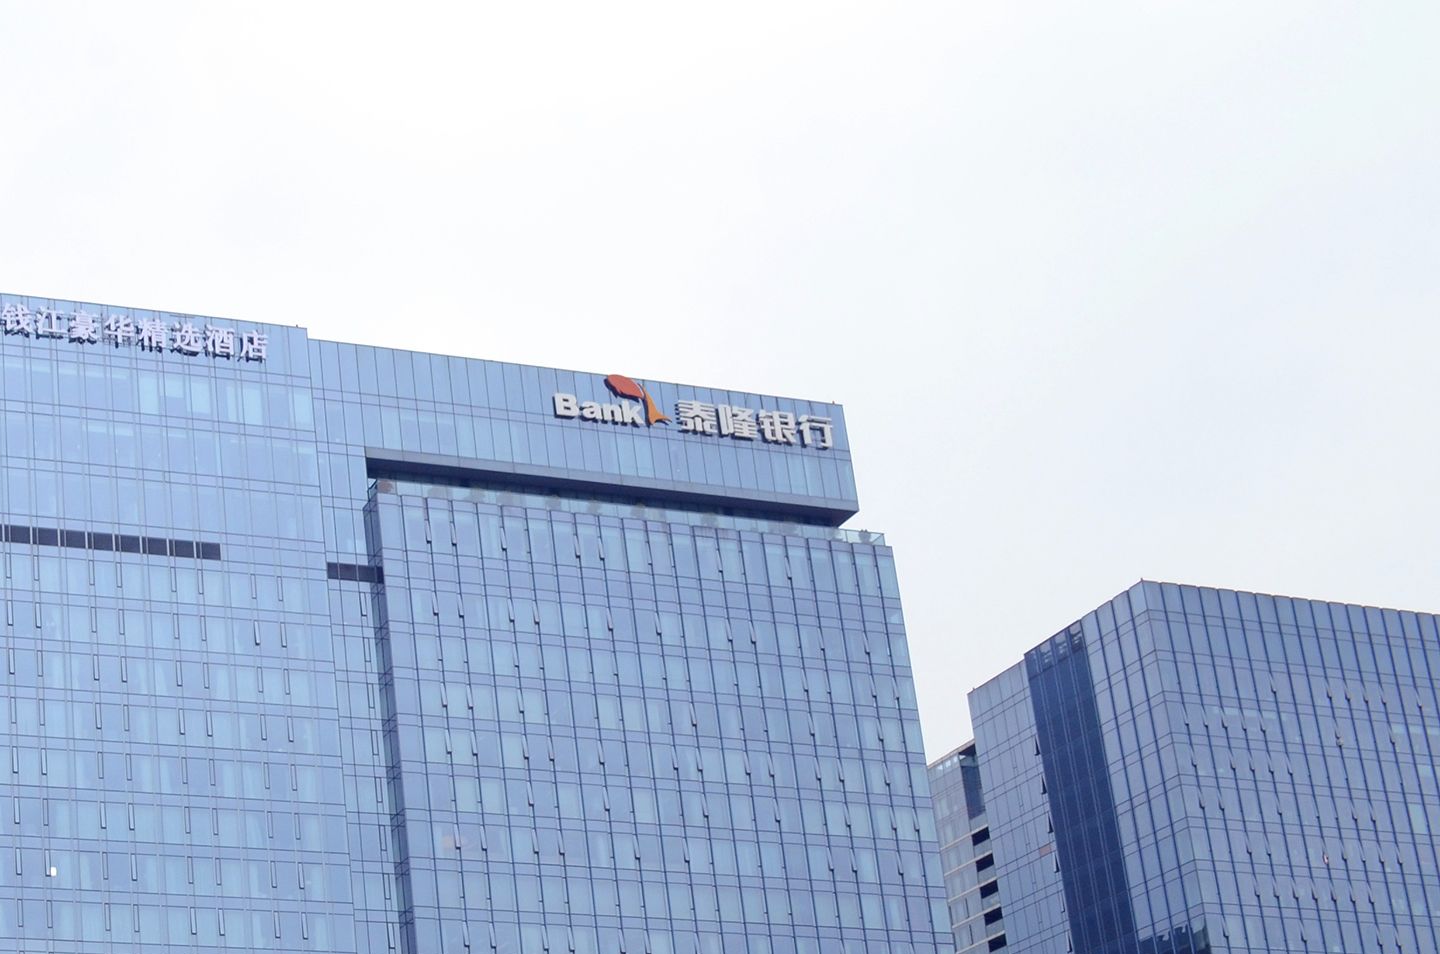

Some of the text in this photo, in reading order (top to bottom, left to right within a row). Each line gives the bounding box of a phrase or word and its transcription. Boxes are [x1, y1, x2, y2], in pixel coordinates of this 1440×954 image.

[554, 392, 646, 426] Bank
[675, 399, 833, 448] 泰隆银行
